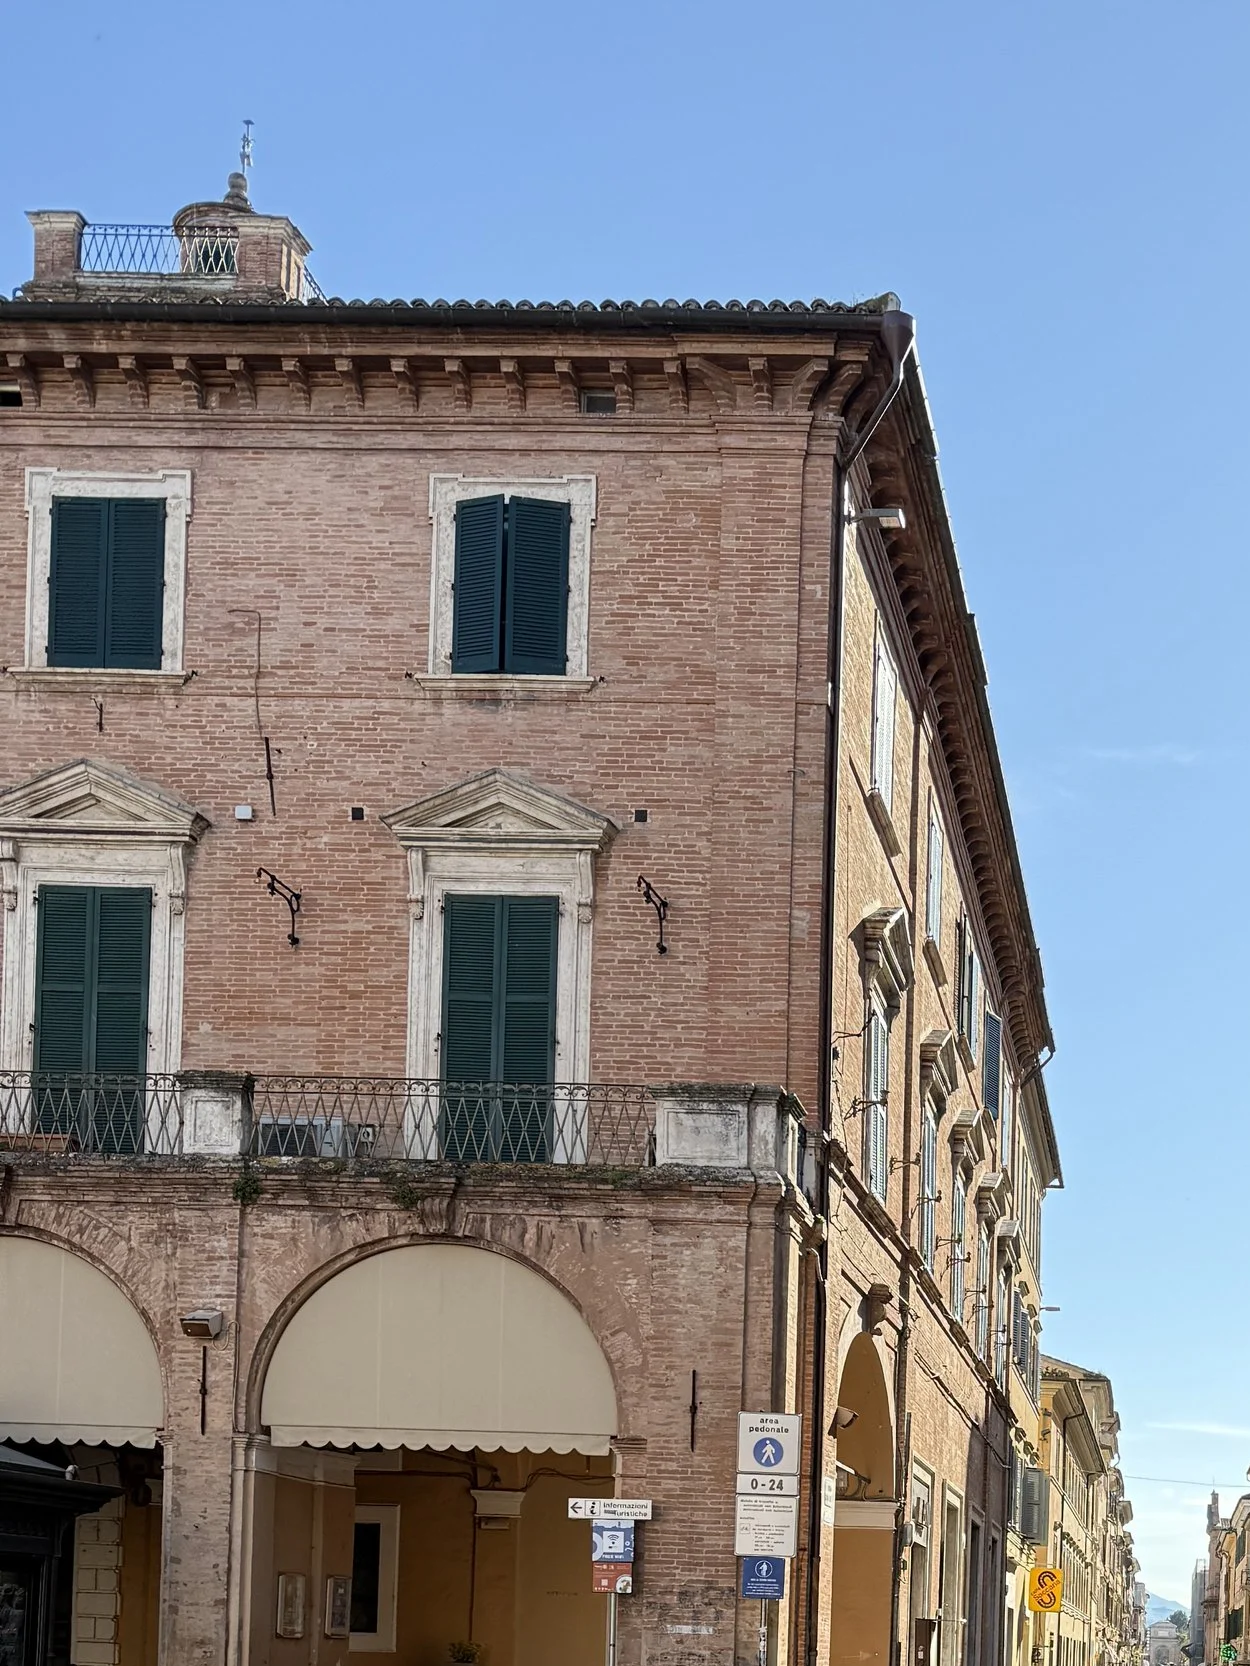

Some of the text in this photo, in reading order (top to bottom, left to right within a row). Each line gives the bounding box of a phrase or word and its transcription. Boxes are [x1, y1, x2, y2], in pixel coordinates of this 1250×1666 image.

[759, 1417, 779, 1425] area
[748, 1425, 790, 1434] pedonale
[603, 1502, 649, 1510] Informazioni
